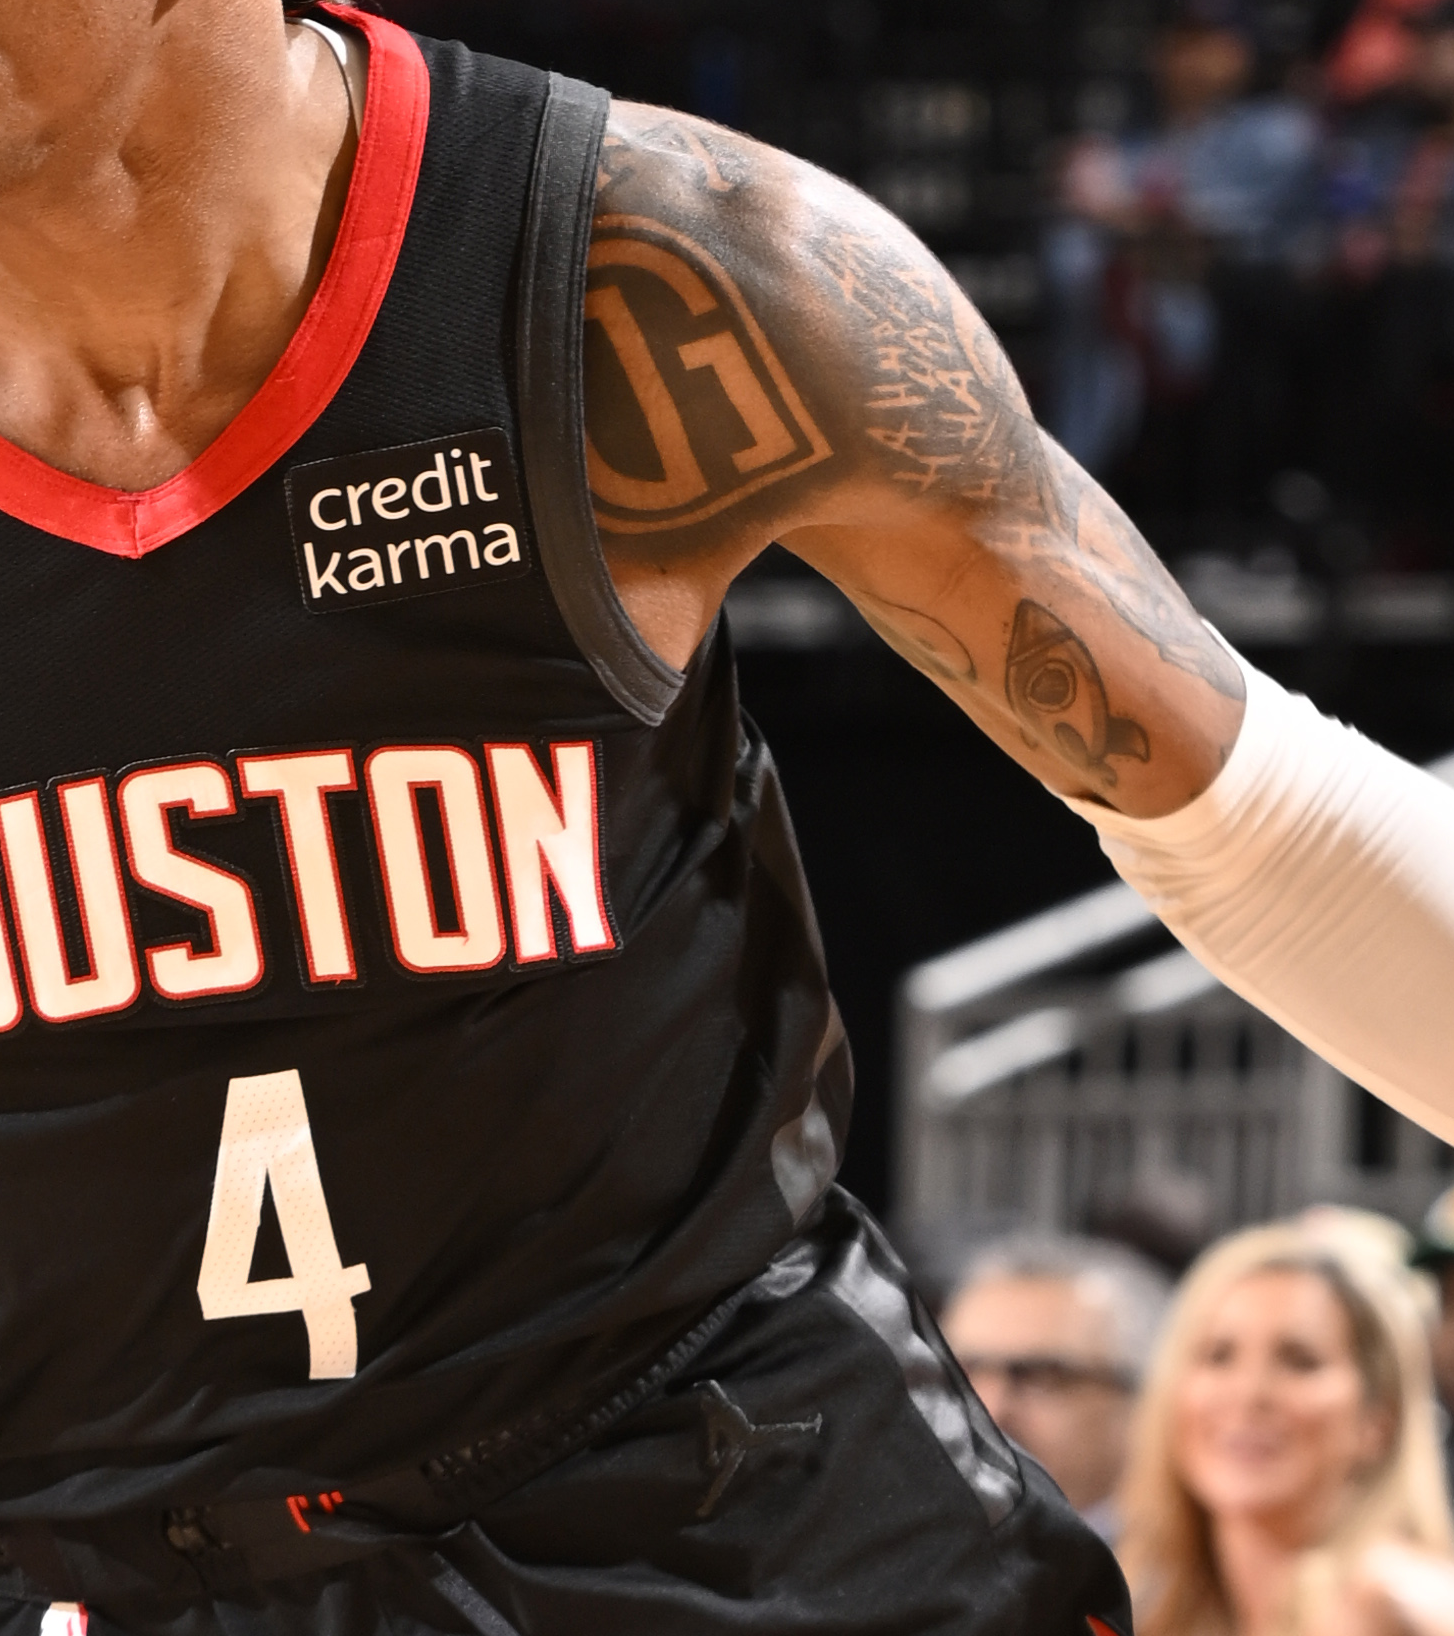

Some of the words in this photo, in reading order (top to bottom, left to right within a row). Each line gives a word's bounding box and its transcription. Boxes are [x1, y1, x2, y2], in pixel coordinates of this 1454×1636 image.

[307, 446, 499, 532] credit
[302, 518, 522, 600] karma
[196, 1068, 372, 1381] 4
